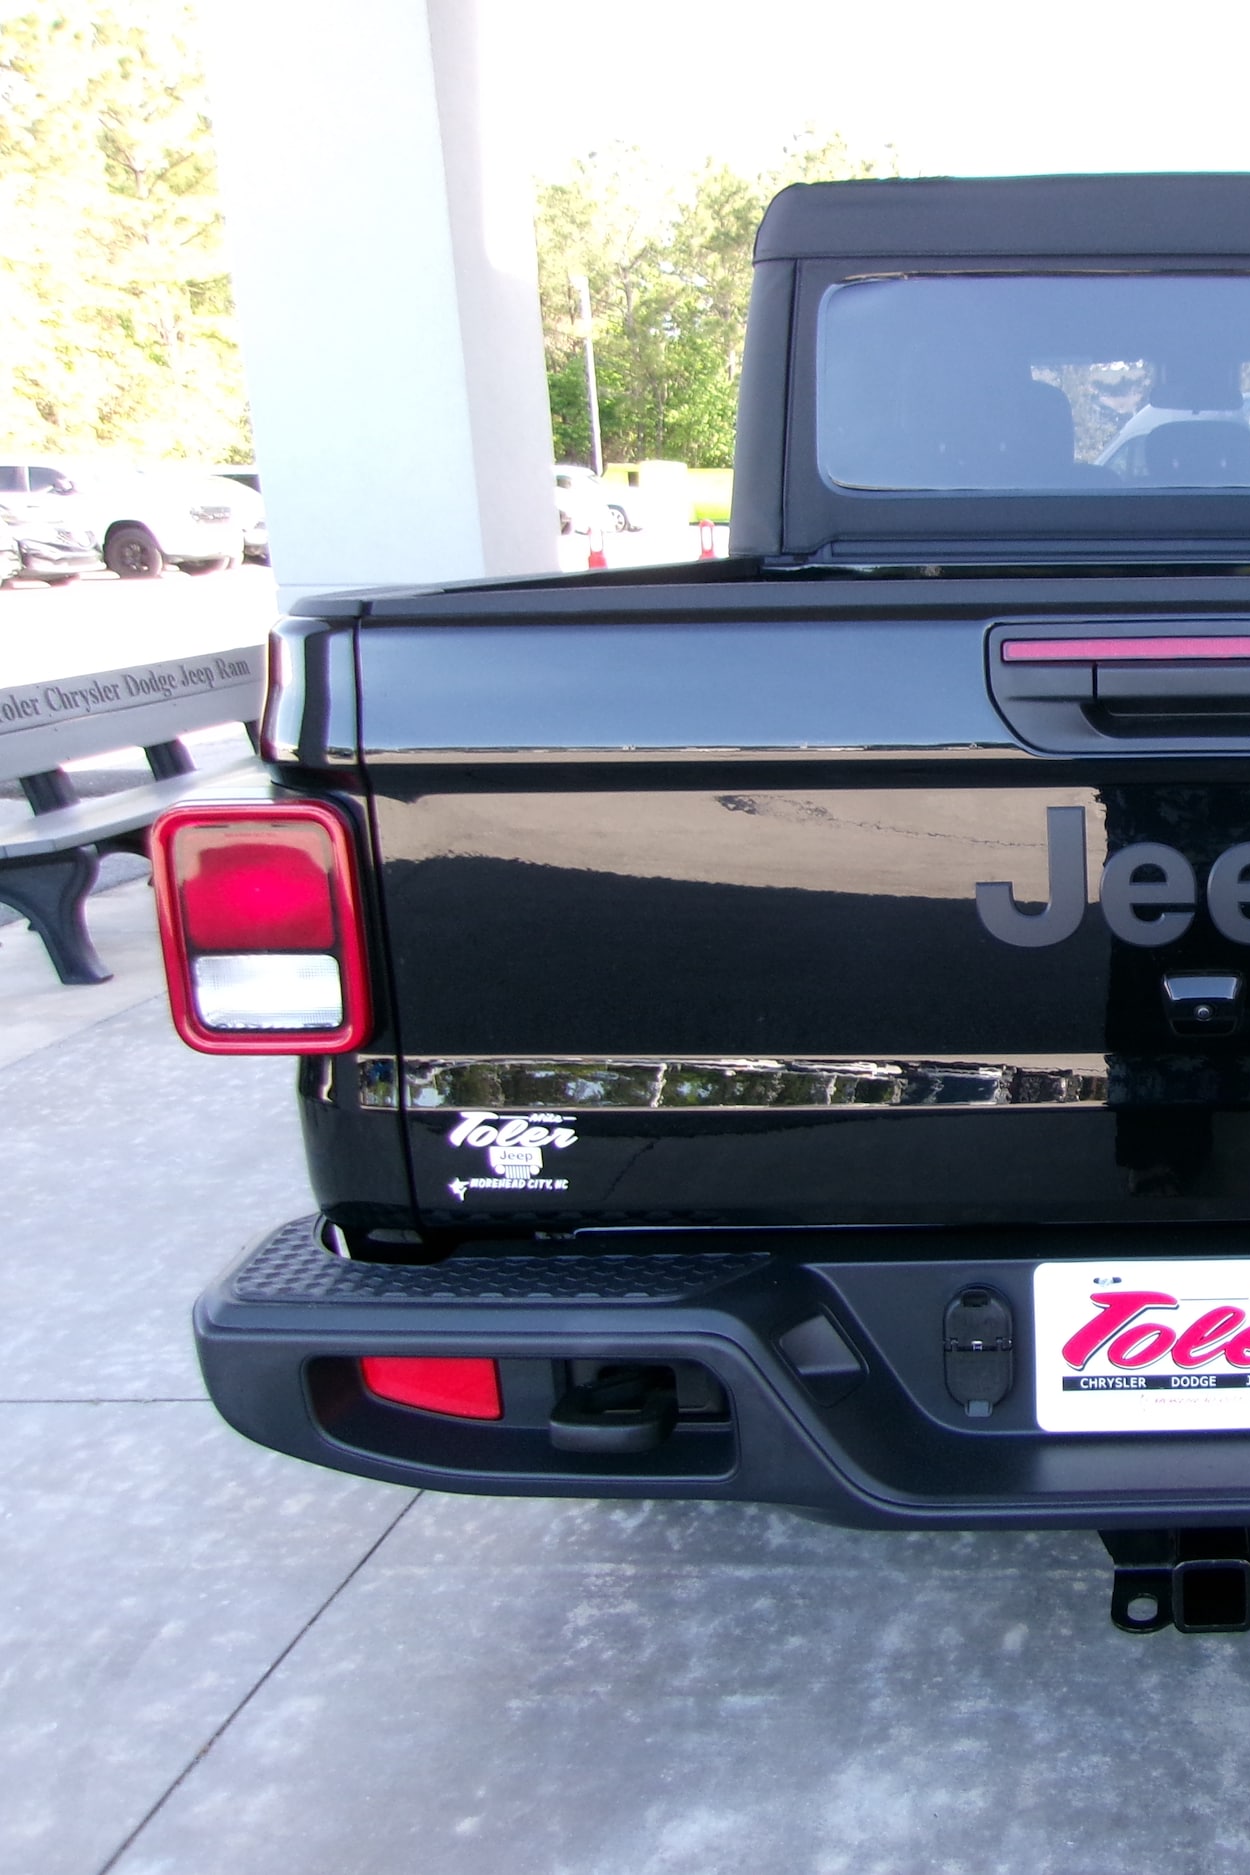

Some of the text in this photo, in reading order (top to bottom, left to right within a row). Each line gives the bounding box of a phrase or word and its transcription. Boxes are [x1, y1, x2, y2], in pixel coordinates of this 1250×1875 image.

[44, 681, 121, 713] Chrysler
[122, 673, 177, 697] Dodge
[181, 664, 215, 688] Jeep
[216, 658, 250, 679] Ram
[450, 1111, 579, 1149] Toler
[500, 1150, 533, 1162] Jeep
[470, 1177, 526, 1189] MOREHEAD
[554, 1179, 569, 1190] NC
[1080, 1377, 1147, 1389] CHRYSLER
[1171, 1376, 1217, 1388] DODGE
